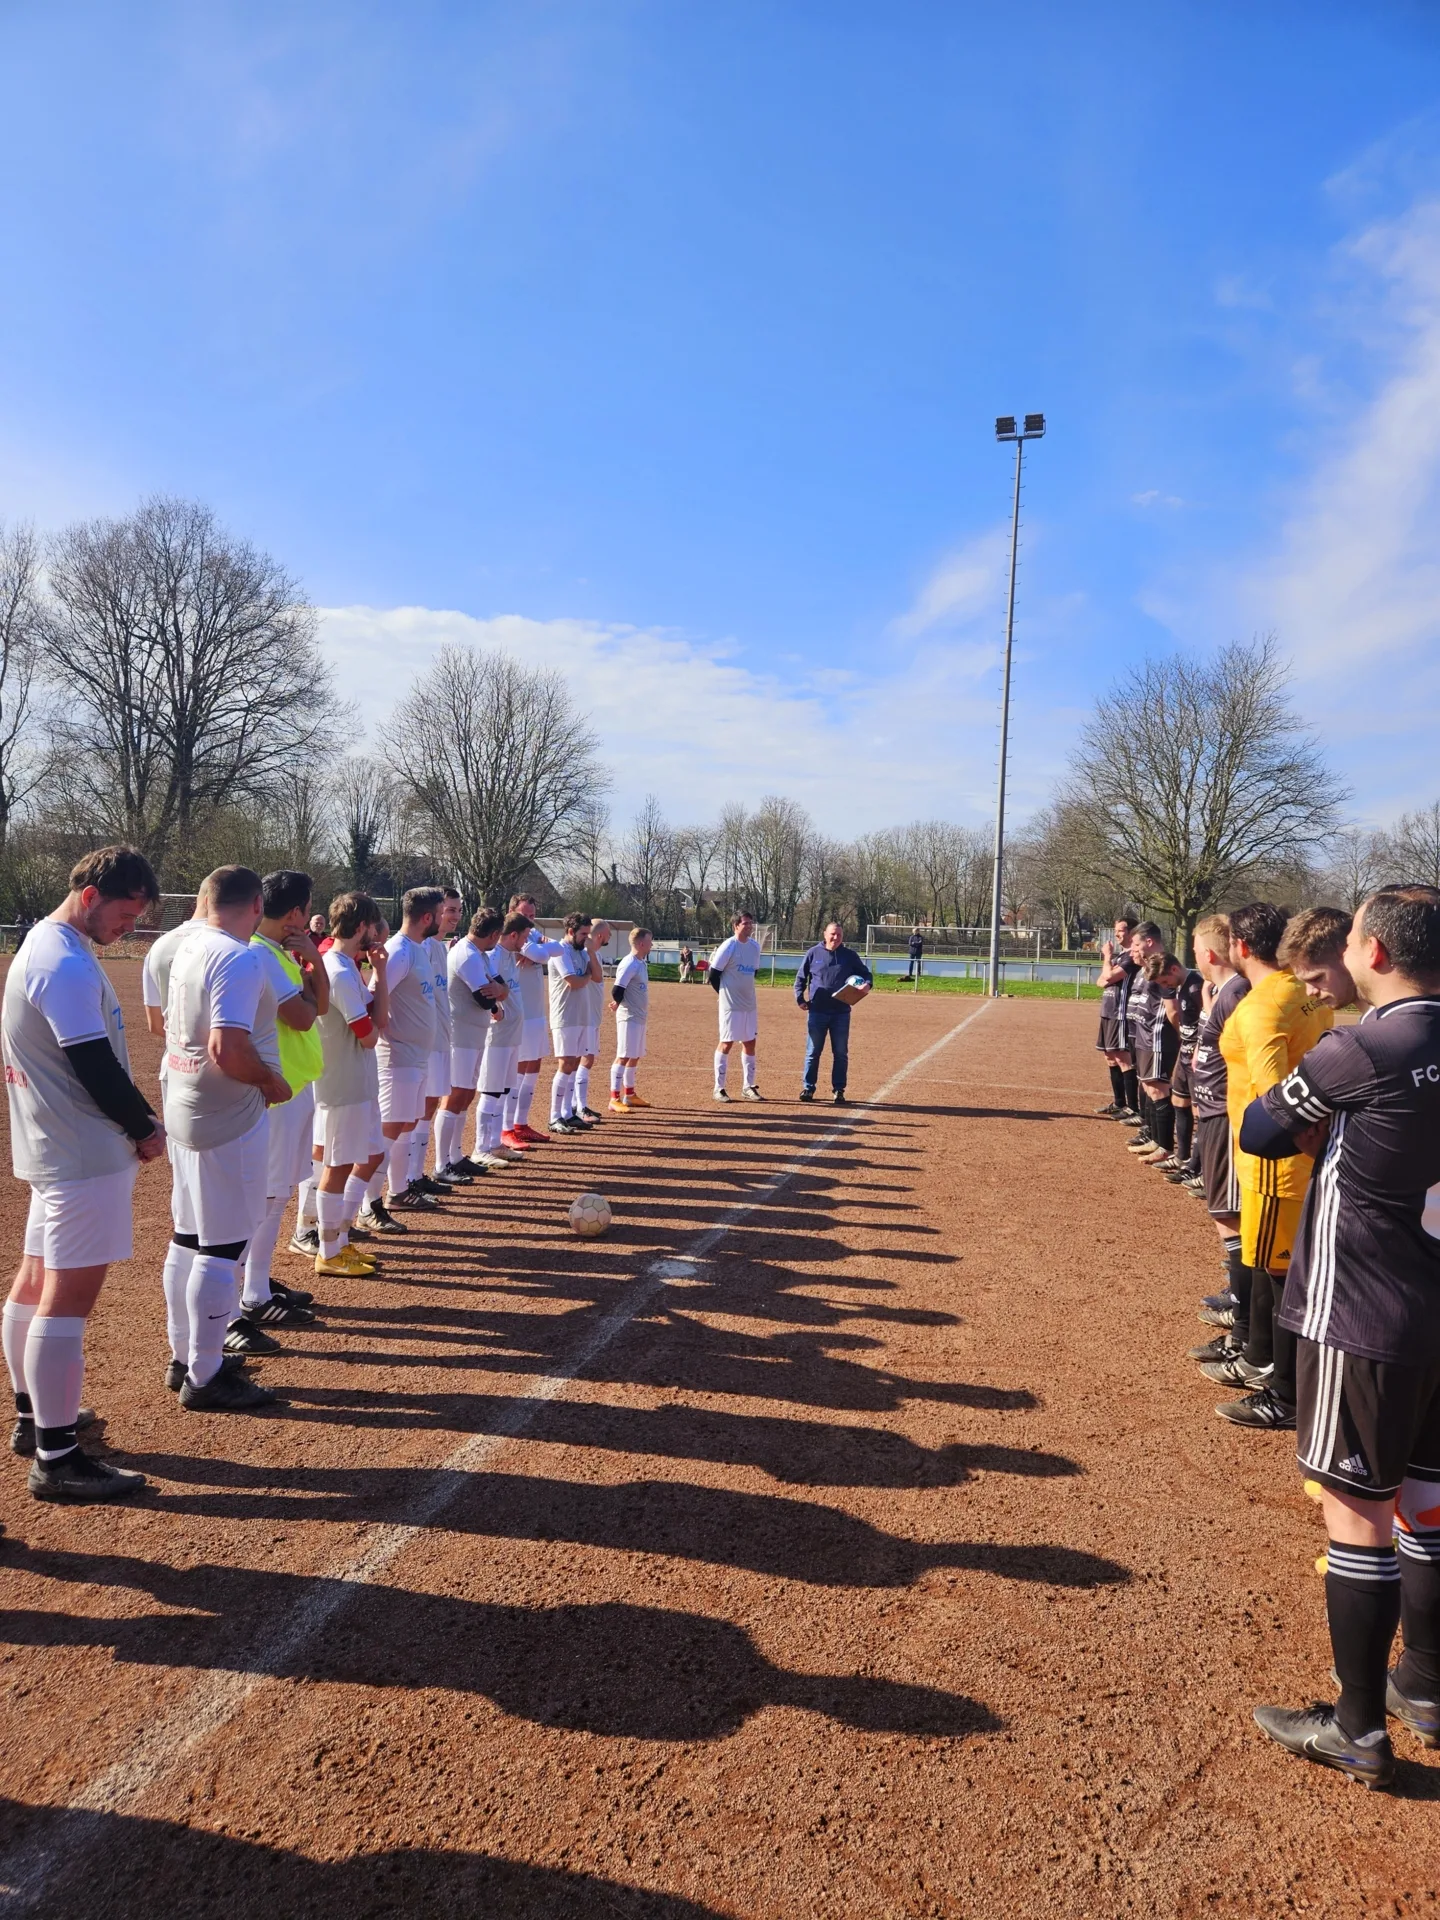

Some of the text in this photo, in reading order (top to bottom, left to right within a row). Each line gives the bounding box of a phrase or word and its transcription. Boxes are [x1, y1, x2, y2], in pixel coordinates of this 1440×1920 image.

[1411, 1064, 1440, 1088] FC
[1282, 1075, 1310, 1106] C
[1338, 1461, 1368, 1476] adidas
